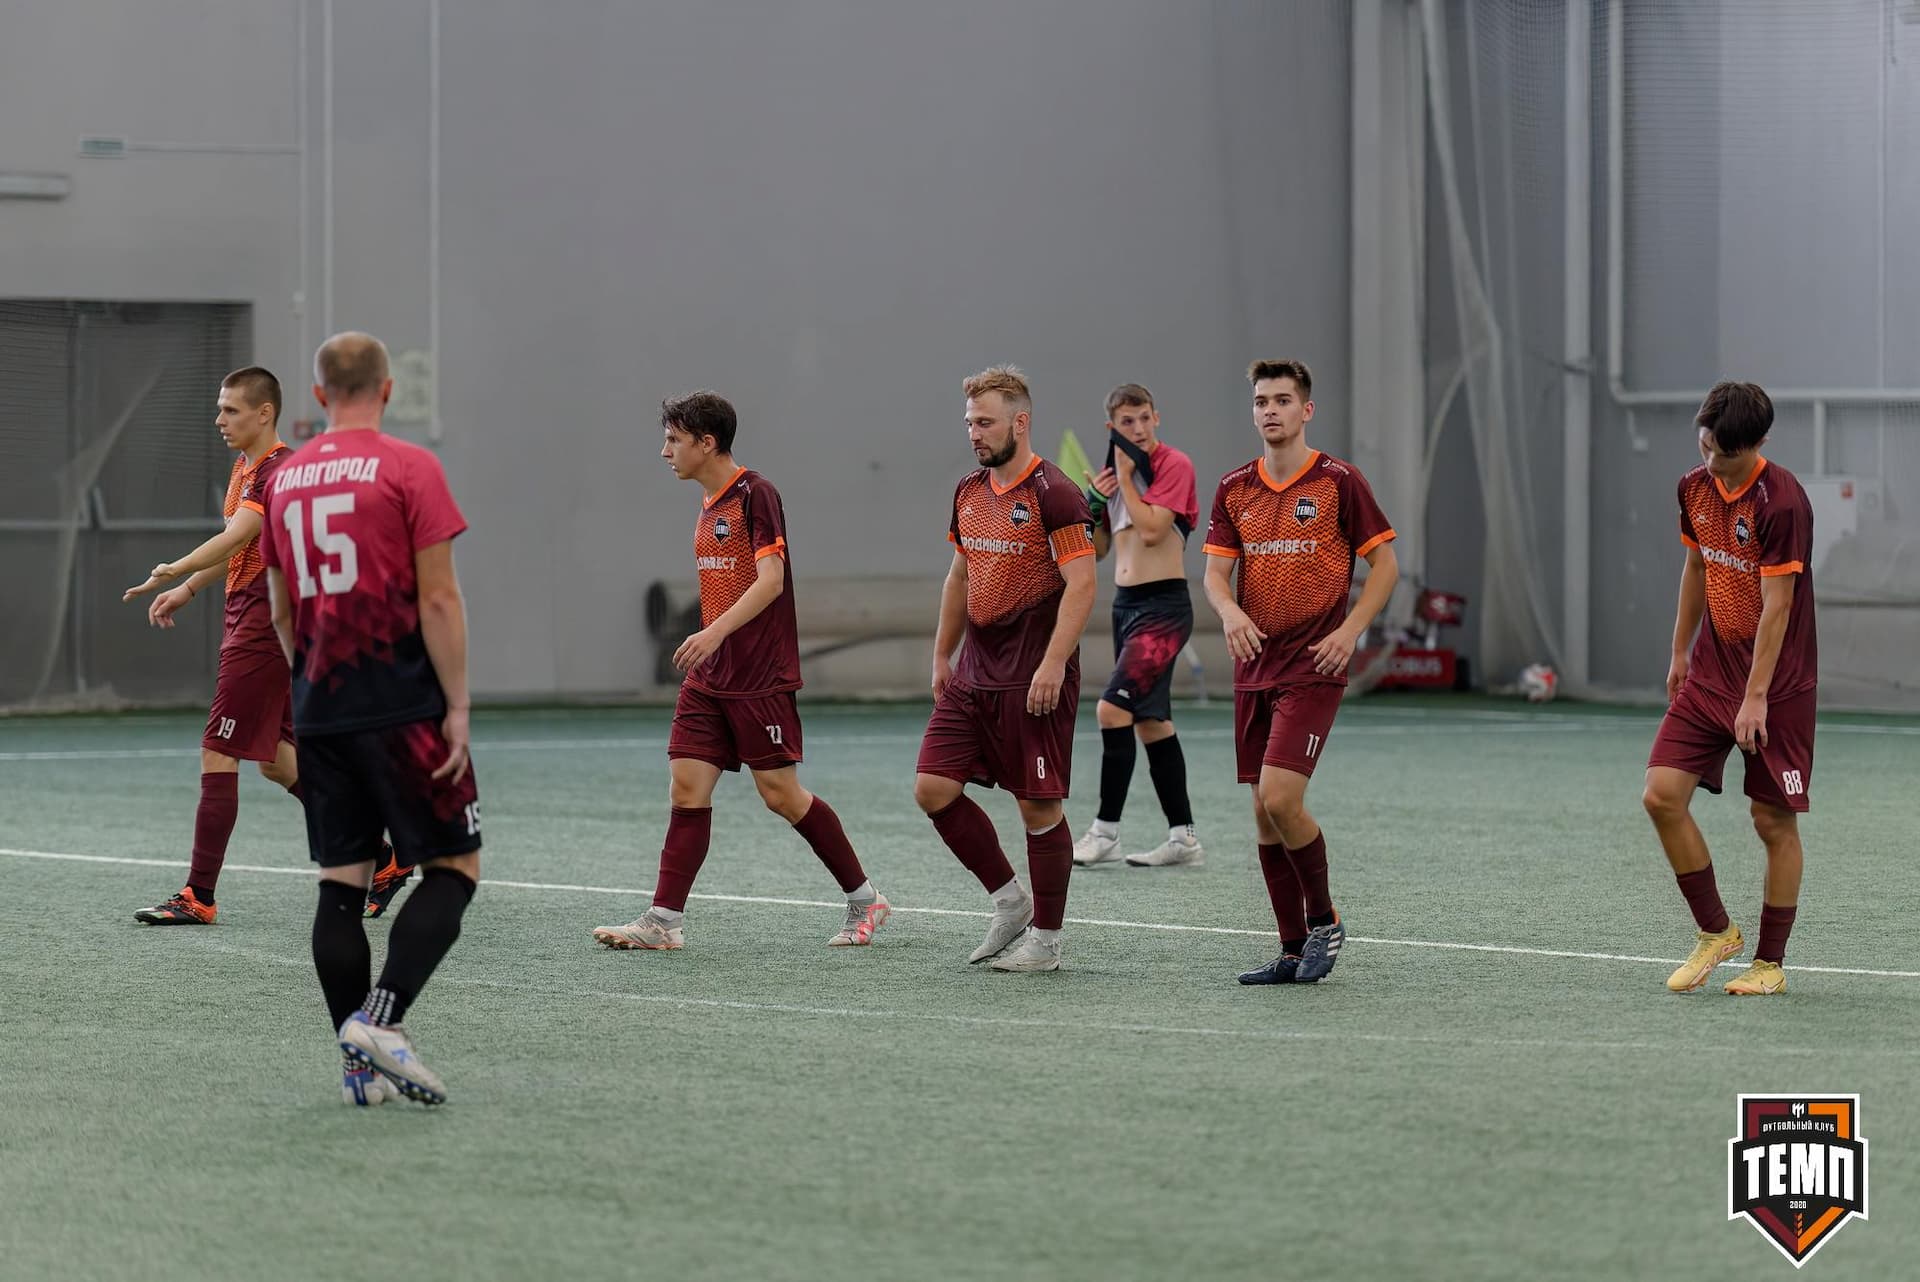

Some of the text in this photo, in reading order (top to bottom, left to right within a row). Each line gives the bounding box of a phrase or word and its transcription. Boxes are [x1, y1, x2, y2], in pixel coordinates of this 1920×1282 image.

[283, 493, 358, 599] 15
[217, 716, 237, 740] 19
[1306, 733, 1320, 759] 11
[1036, 756, 1045, 779] 8
[1782, 769, 1804, 796] 88
